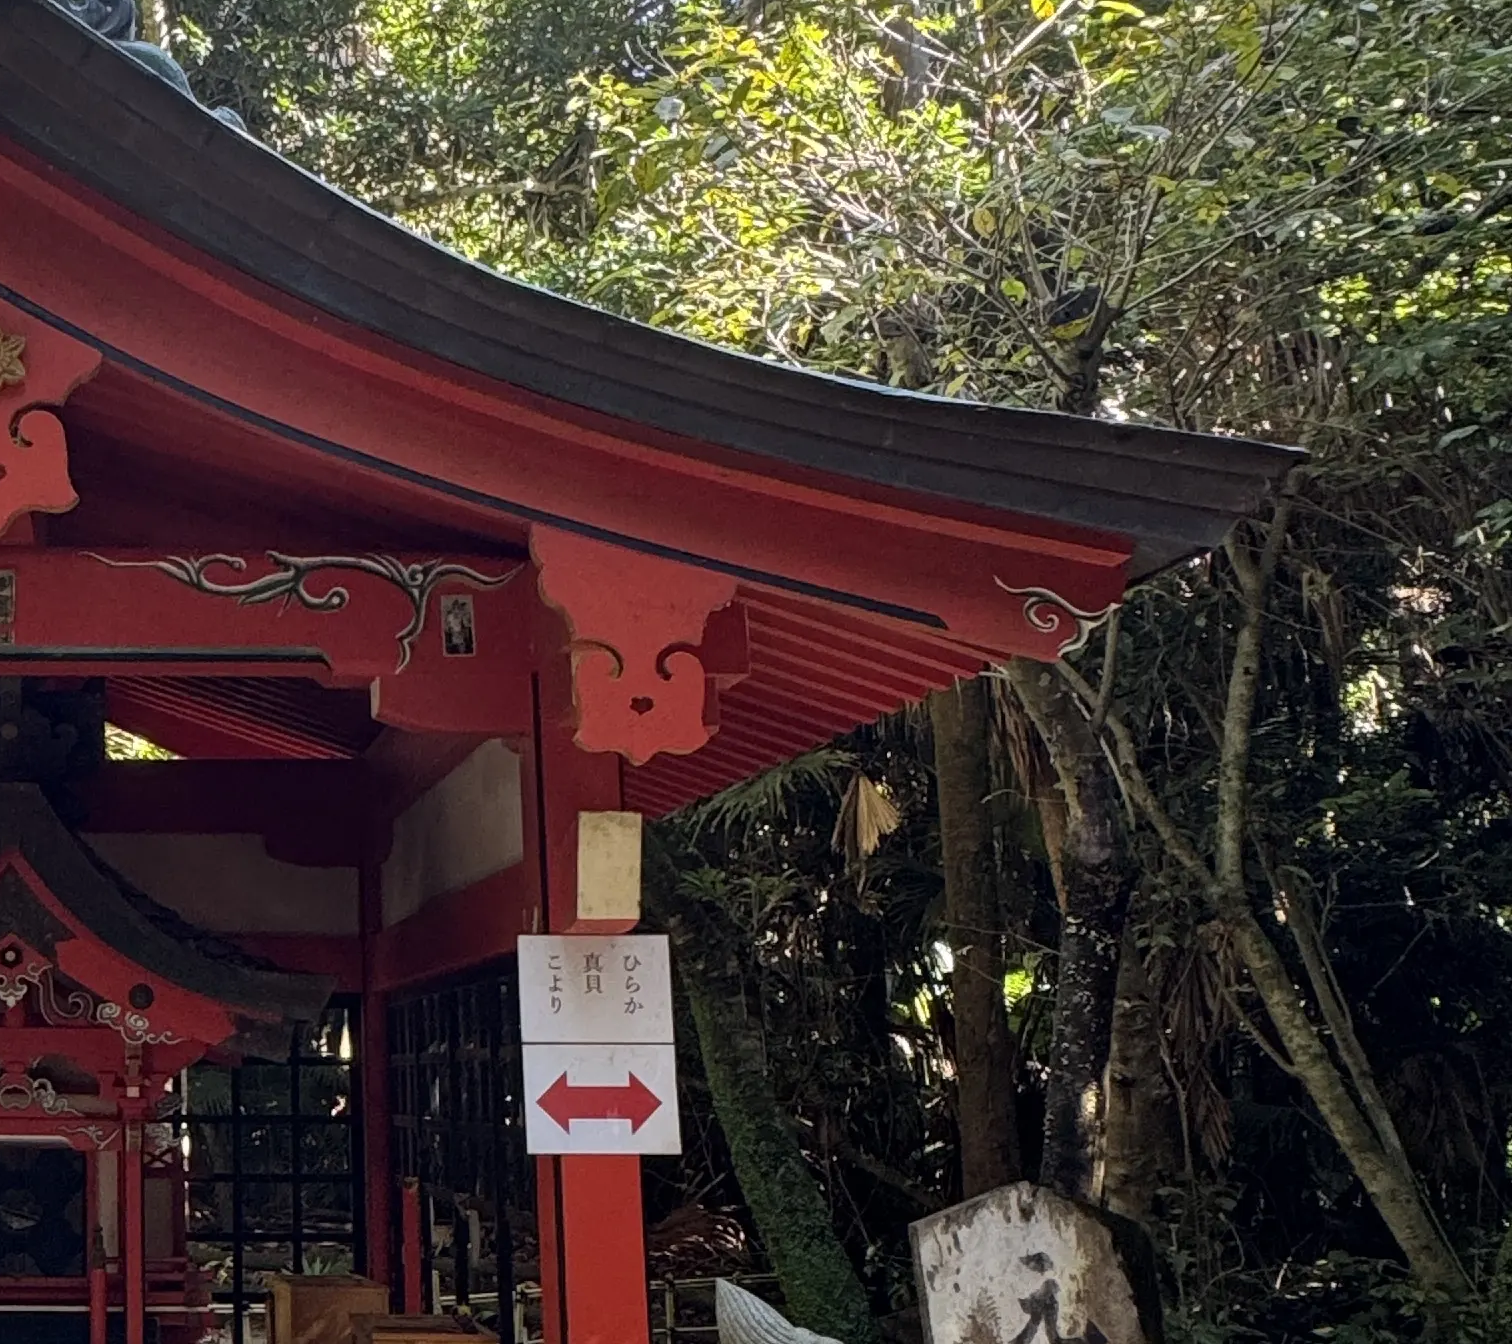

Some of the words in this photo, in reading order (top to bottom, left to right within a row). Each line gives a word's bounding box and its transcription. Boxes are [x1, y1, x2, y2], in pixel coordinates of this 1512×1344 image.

[548, 955, 563, 1014] こより
[583, 952, 603, 994] 真貝
[623, 955, 644, 1014] ひらか
